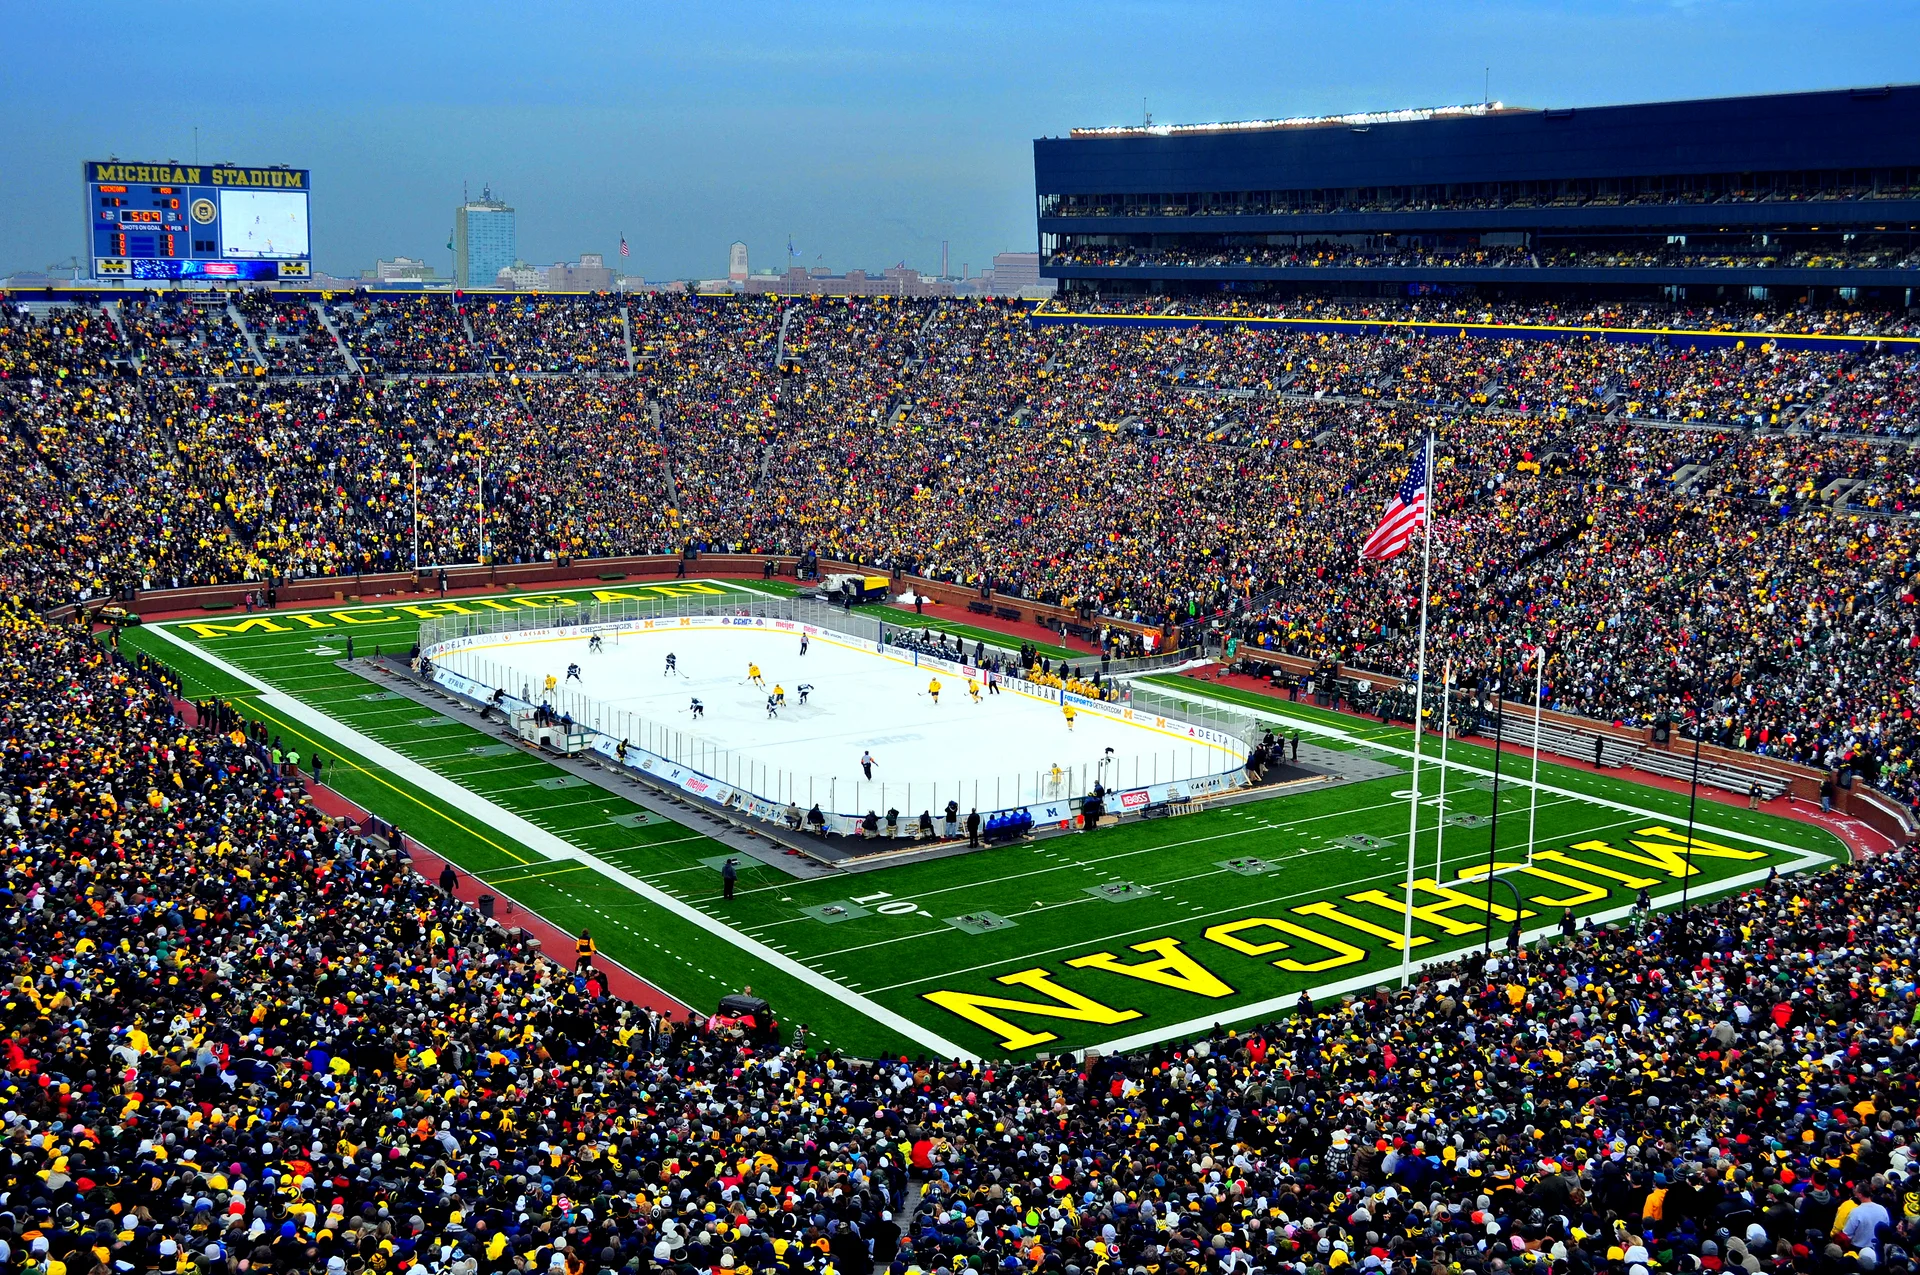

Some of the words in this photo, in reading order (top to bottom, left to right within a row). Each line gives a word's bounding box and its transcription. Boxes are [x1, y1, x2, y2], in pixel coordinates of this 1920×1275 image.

[97, 165, 201, 184] MICHIGAN
[212, 169, 302, 187] STADIUM
[170, 198, 179, 209] 0
[131, 211, 160, 222] 5:09
[178, 583, 727, 638] MICHIGAN
[776, 620, 794, 630] meijer
[1004, 677, 1056, 700] MICHIGAN
[1198, 729, 1228, 745] DELTA
[685, 777, 709, 792] meijer
[1127, 793, 1148, 804] BOSS
[1046, 808, 1058, 817] M
[849, 891, 918, 914] 10
[922, 825, 1768, 1051] MICHIGAN
